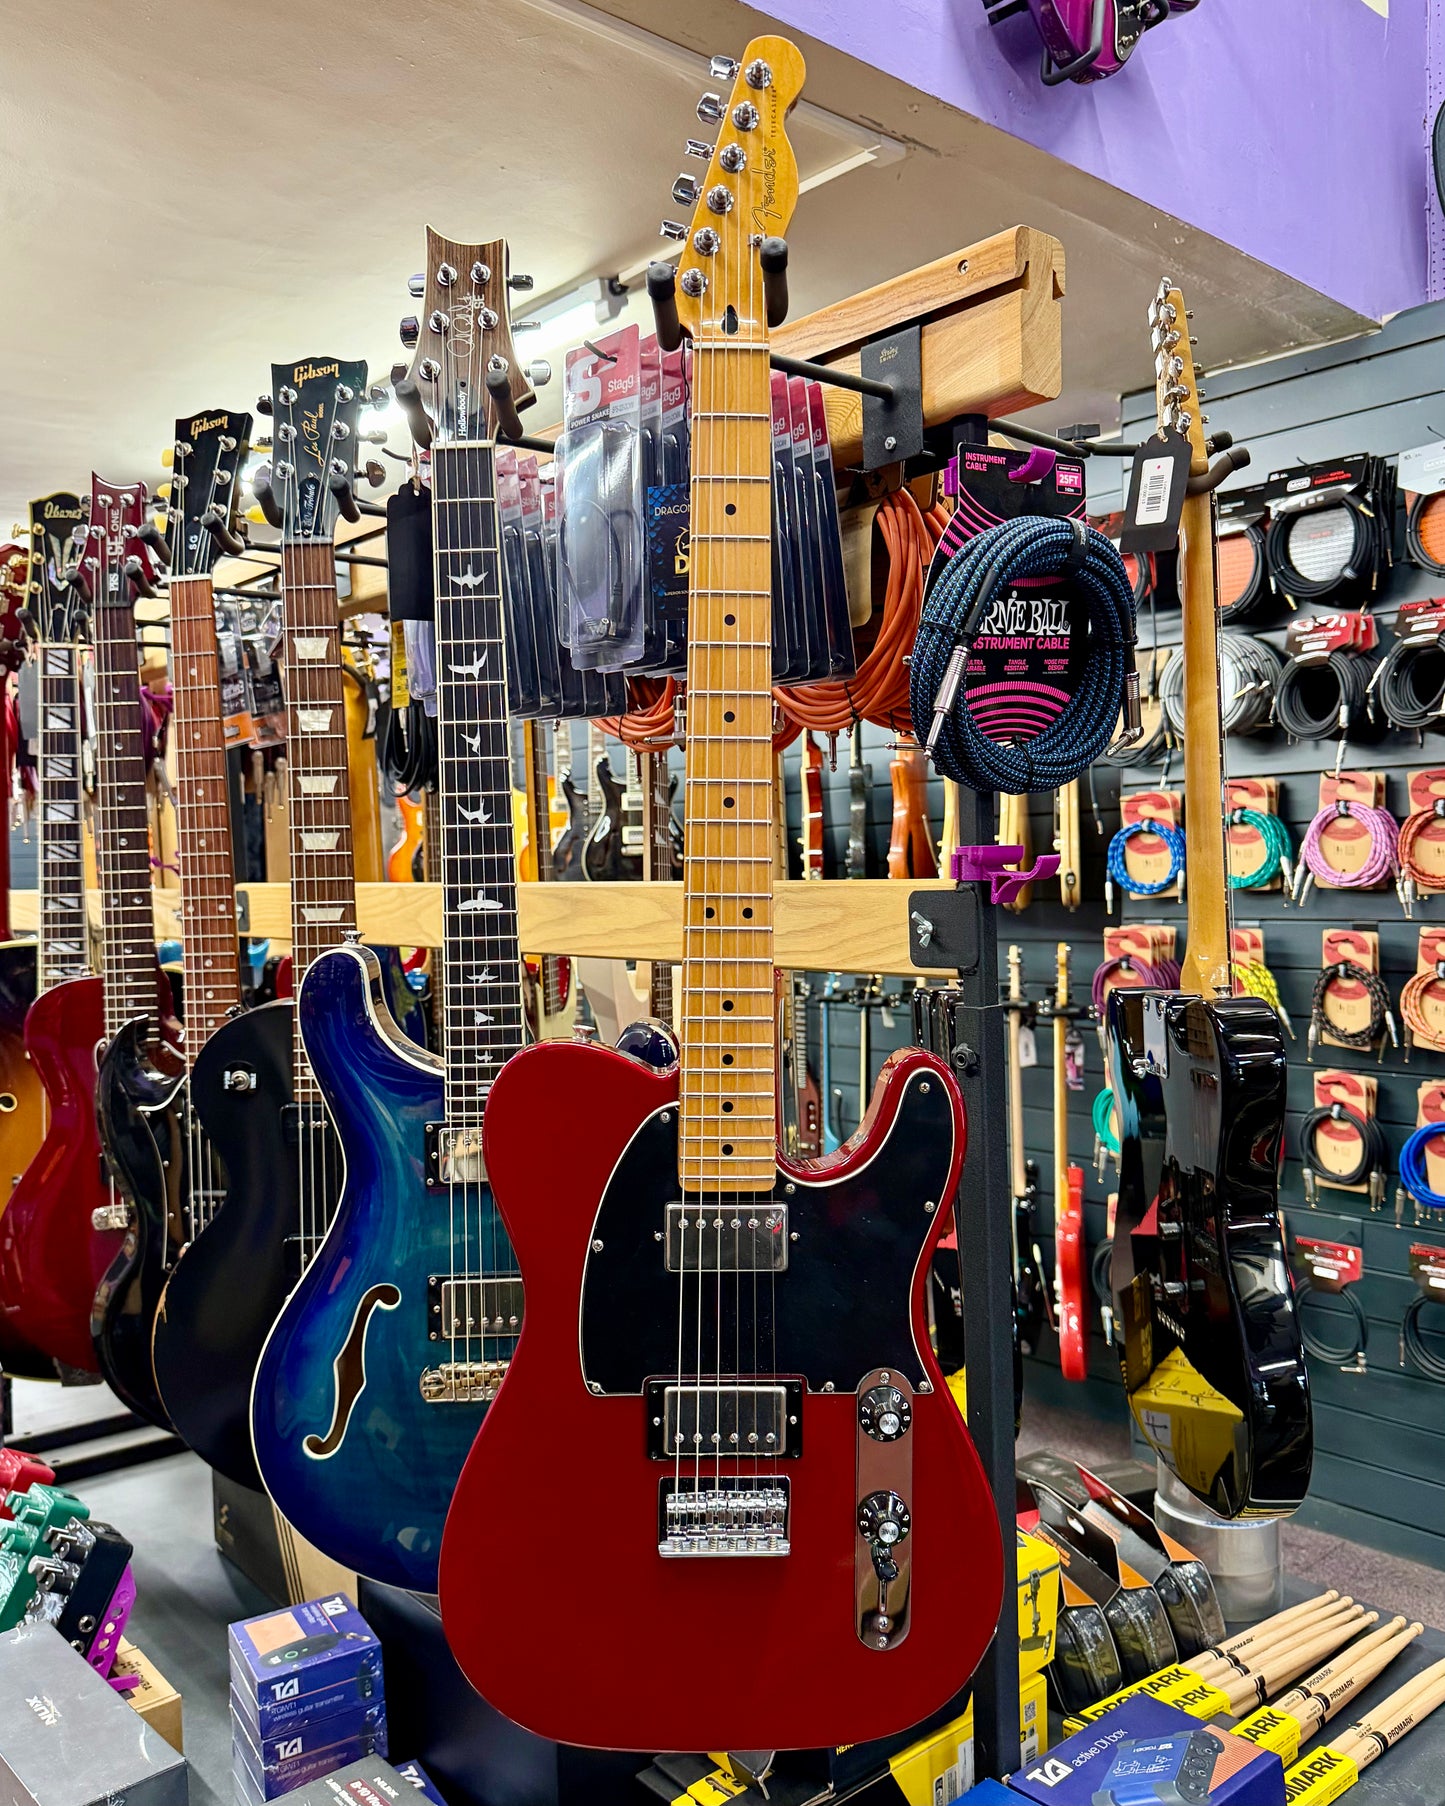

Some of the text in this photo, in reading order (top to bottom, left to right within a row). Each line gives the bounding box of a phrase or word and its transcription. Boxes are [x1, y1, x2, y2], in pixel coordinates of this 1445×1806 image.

[752, 148, 783, 231] Fender
[474, 294, 485, 309] SE
[293, 362, 340, 389] Gibson
[608, 375, 634, 393] Stagg
[641, 382, 657, 400] agg
[663, 386, 681, 405] agg
[458, 390, 468, 437] Hollowbody
[570, 408, 610, 429] POWER SNAKE
[190, 414, 229, 441] Gibson
[301, 411, 325, 468] Les Paul
[965, 452, 1007, 465] INSTRUMENT
[965, 462, 987, 472] CABLE
[1060, 474, 1079, 485] 25FT
[44, 501, 82, 519] Ibanez
[111, 508, 120, 532] ONE
[188, 534, 199, 551] SG
[979, 590, 1071, 636] RNIE BALL
[973, 637, 1070, 650] STRUMENT CABLE
[861, 1406, 871, 1415] 2
[892, 1391, 901, 1403] 10
[863, 1508, 872, 1518] 2
[896, 1501, 904, 1513] 10
[270, 1677, 299, 1701] TGI
[1307, 1667, 1334, 1689] PROMARK
[1329, 1677, 1355, 1701] PROMARK
[1090, 1668, 1191, 1718] PROARK
[1387, 1714, 1414, 1740] PROMARK
[275, 1736, 303, 1761] TGI
[1026, 1757, 1074, 1787] TGI
[1071, 1746, 1101, 1768] active
[1098, 1736, 1110, 1751] DI
[1107, 1728, 1129, 1744] box
[349, 1780, 372, 1797] B-10
[373, 1776, 400, 1799] NUX
[1285, 1751, 1343, 1804] OMARK
